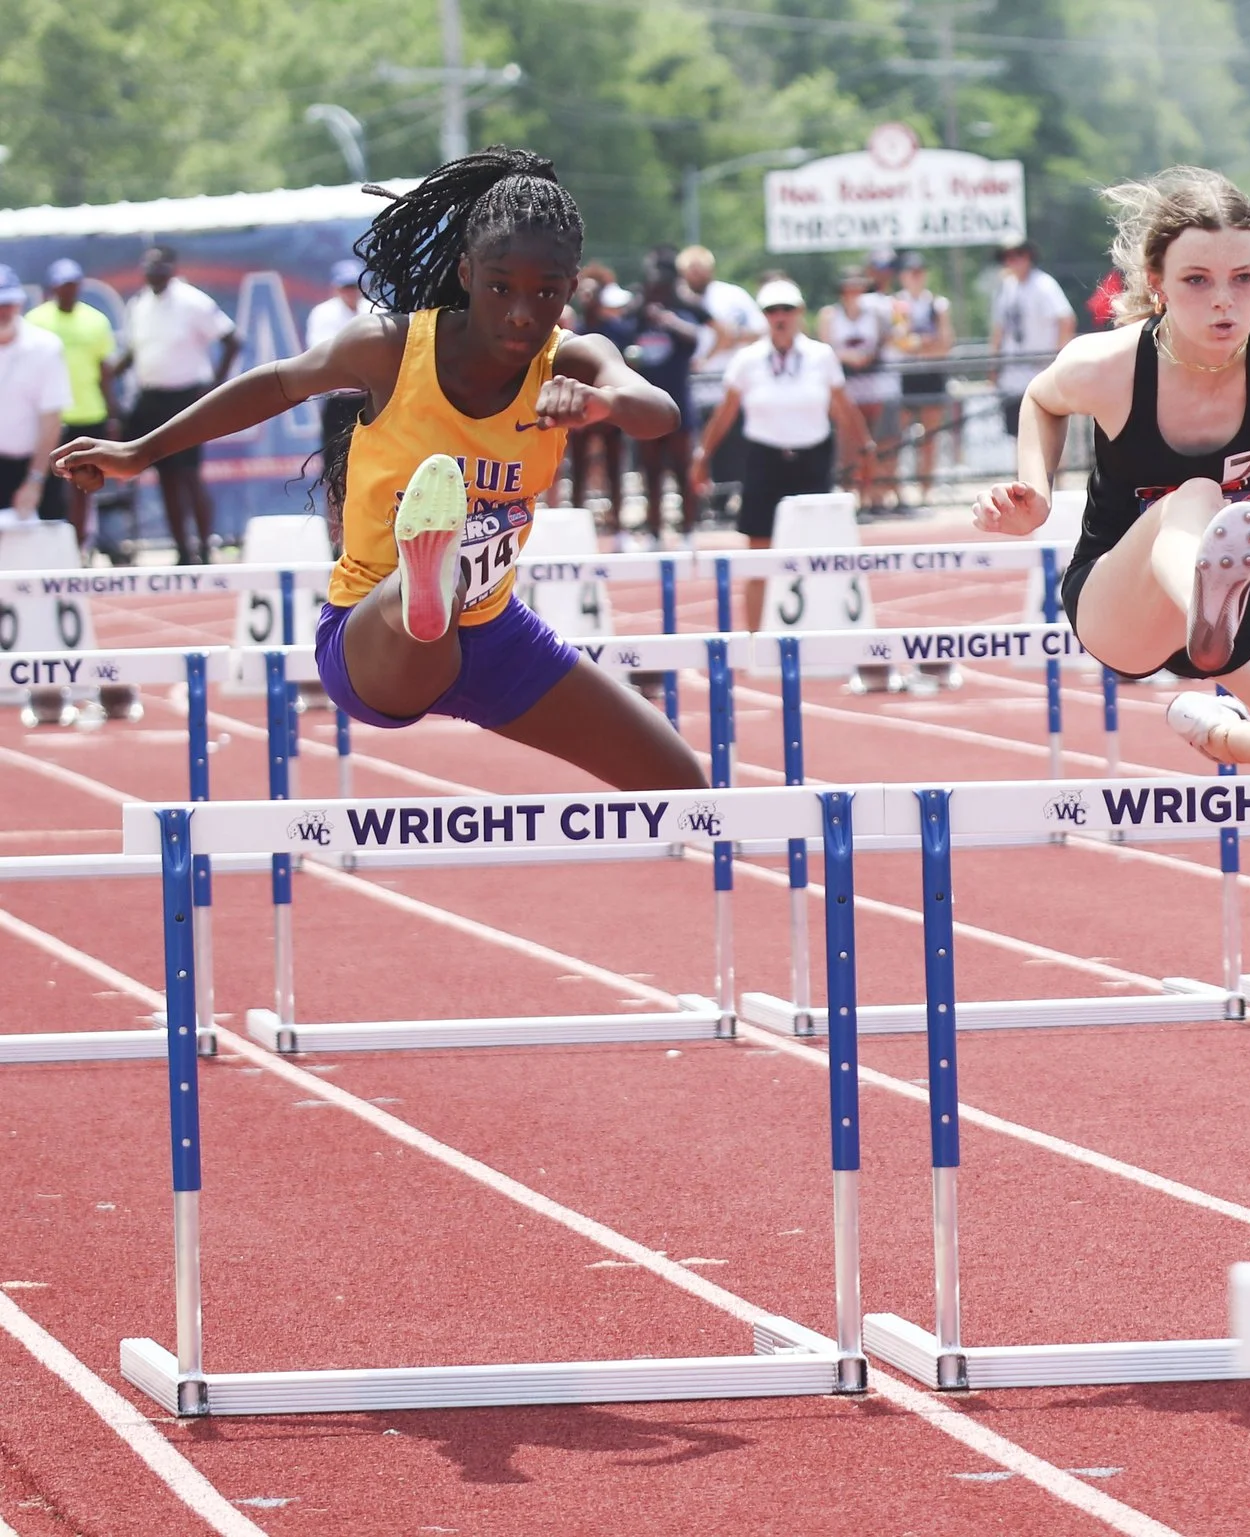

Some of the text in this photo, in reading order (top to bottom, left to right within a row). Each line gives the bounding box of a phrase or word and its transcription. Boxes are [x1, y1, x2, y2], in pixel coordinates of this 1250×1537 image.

[916, 203, 1018, 235] ARENA
[455, 455, 523, 493] LUE
[461, 531, 514, 589] 14
[531, 563, 583, 581] CITY
[808, 552, 905, 573] WRIGHT
[912, 550, 967, 570] CITY
[41, 574, 139, 595] WRIGHT
[149, 573, 202, 592] CITY
[902, 631, 1031, 659] WRIGHT
[10, 659, 83, 685] CITY
[346, 803, 546, 846] WRIGHT
[559, 801, 670, 841] CITY
